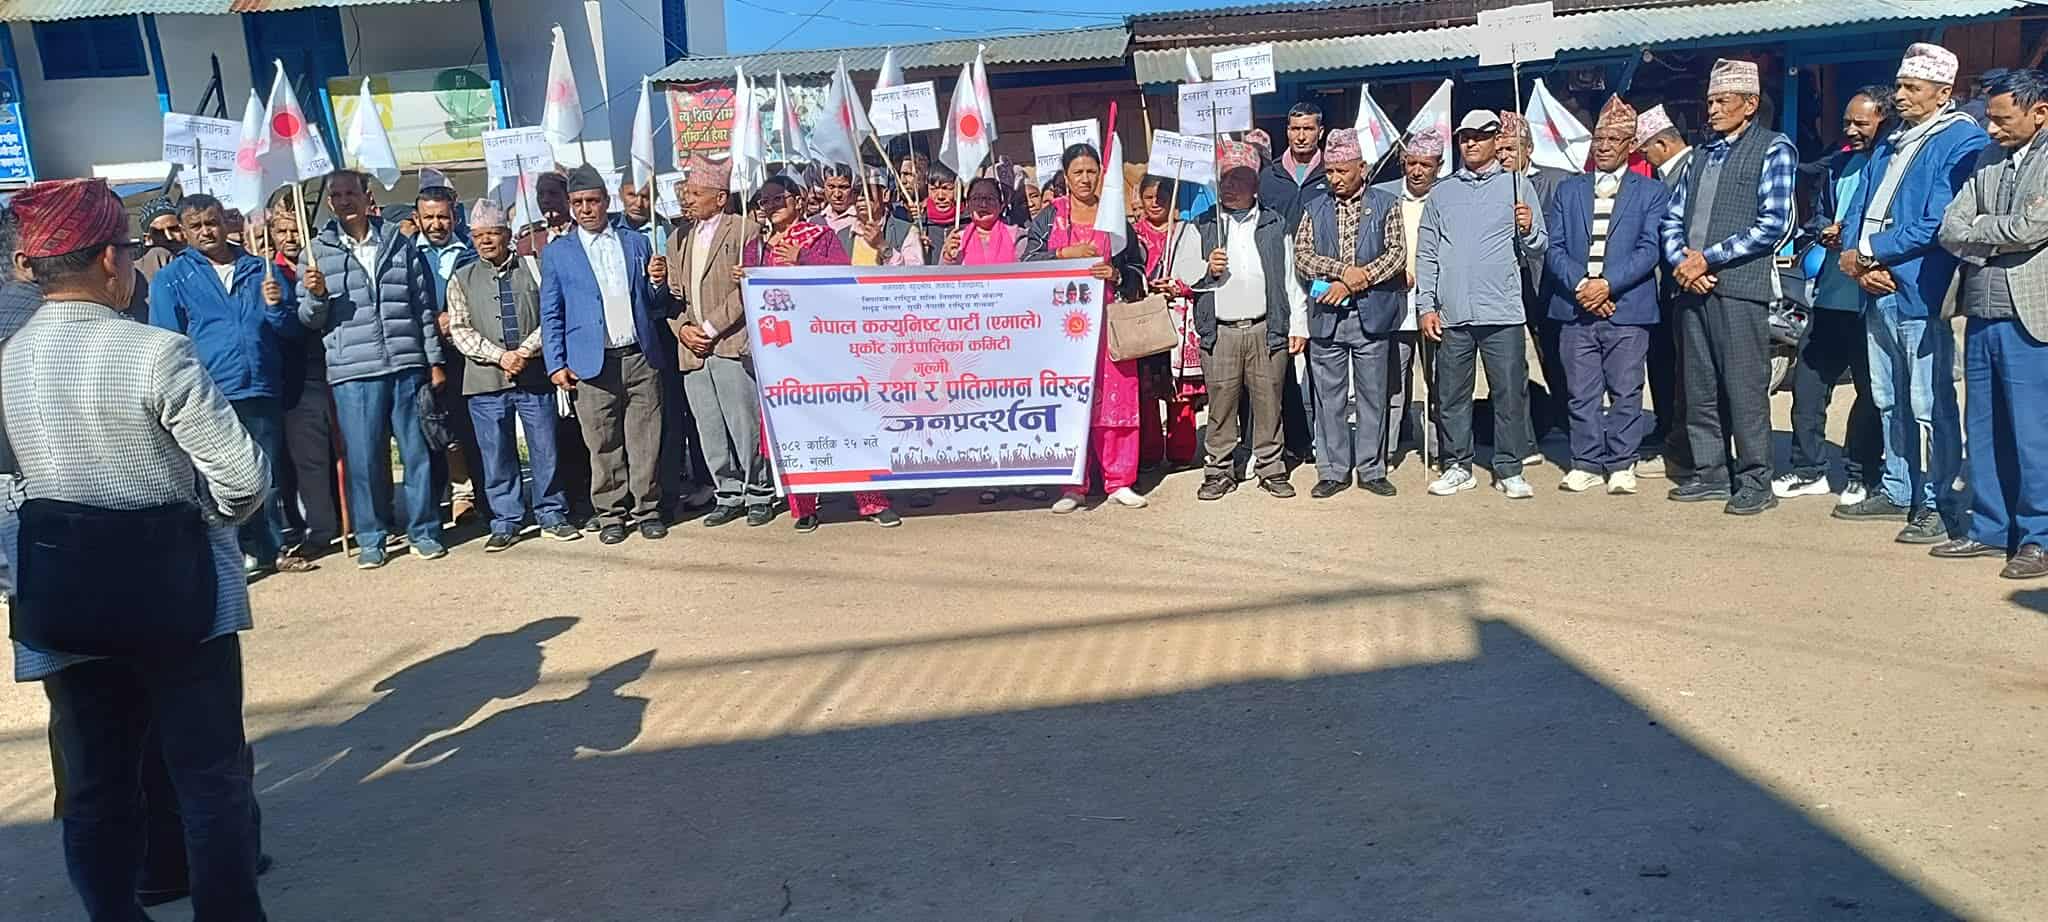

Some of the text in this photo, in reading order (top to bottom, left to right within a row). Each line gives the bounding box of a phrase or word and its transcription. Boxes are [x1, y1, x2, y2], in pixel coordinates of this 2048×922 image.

[1183, 85, 1248, 102] दलाल सरकार
[809, 310, 1042, 337] नेपाल कम्युनिष्ट पार्टी (एमाले)
[969, 335, 1011, 350] कमिटी
[913, 359, 949, 377] गुल्मी
[764, 376, 870, 407] संविधानको
[878, 381, 917, 403] रक्षा
[924, 381, 938, 402] र
[947, 374, 1032, 401] प्रतिगमन
[880, 399, 1062, 433] जनप्रदर्शन
[805, 436, 838, 450] कार्तिक
[844, 438, 857, 449] २५
[863, 434, 880, 449] गते
[809, 453, 833, 470] गुल्मी
